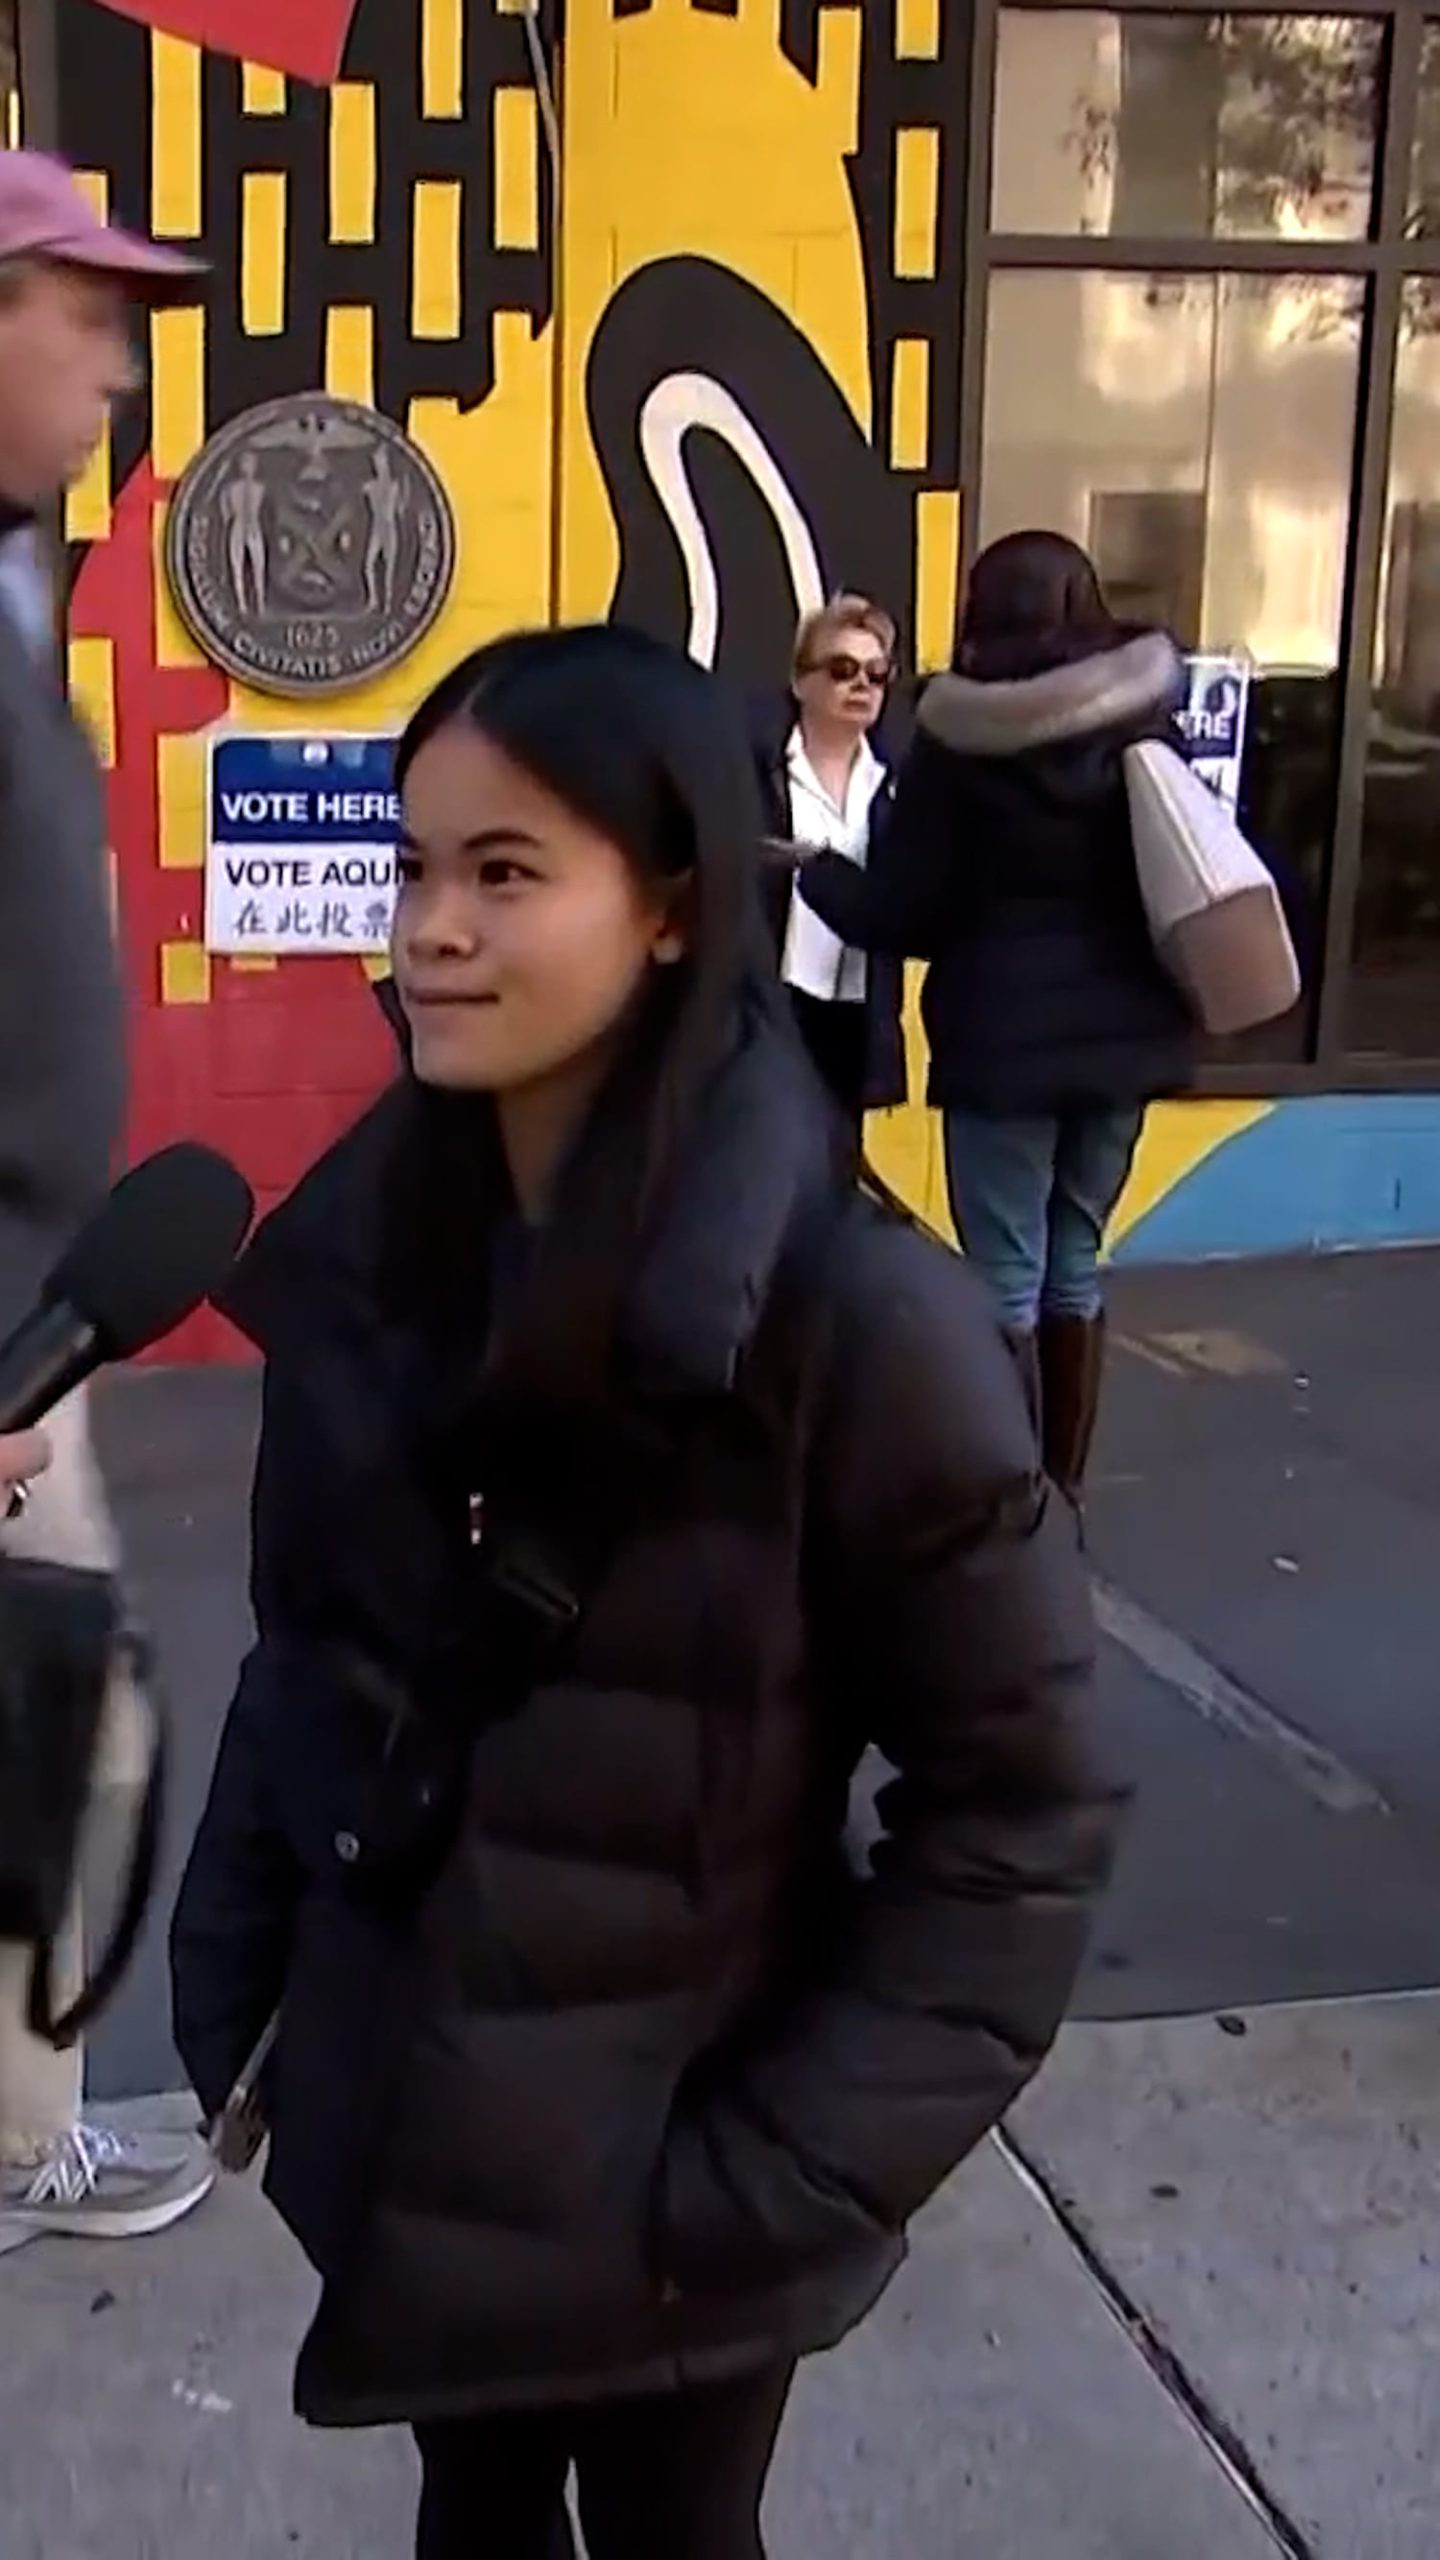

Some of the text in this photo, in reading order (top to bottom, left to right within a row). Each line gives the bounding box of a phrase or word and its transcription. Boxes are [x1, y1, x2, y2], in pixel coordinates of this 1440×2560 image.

[286, 624, 339, 649] 1625
[221, 792, 400, 822] VOTE HERE
[226, 861, 310, 886] VOTE
[234, 899, 388, 938] 在此投票
